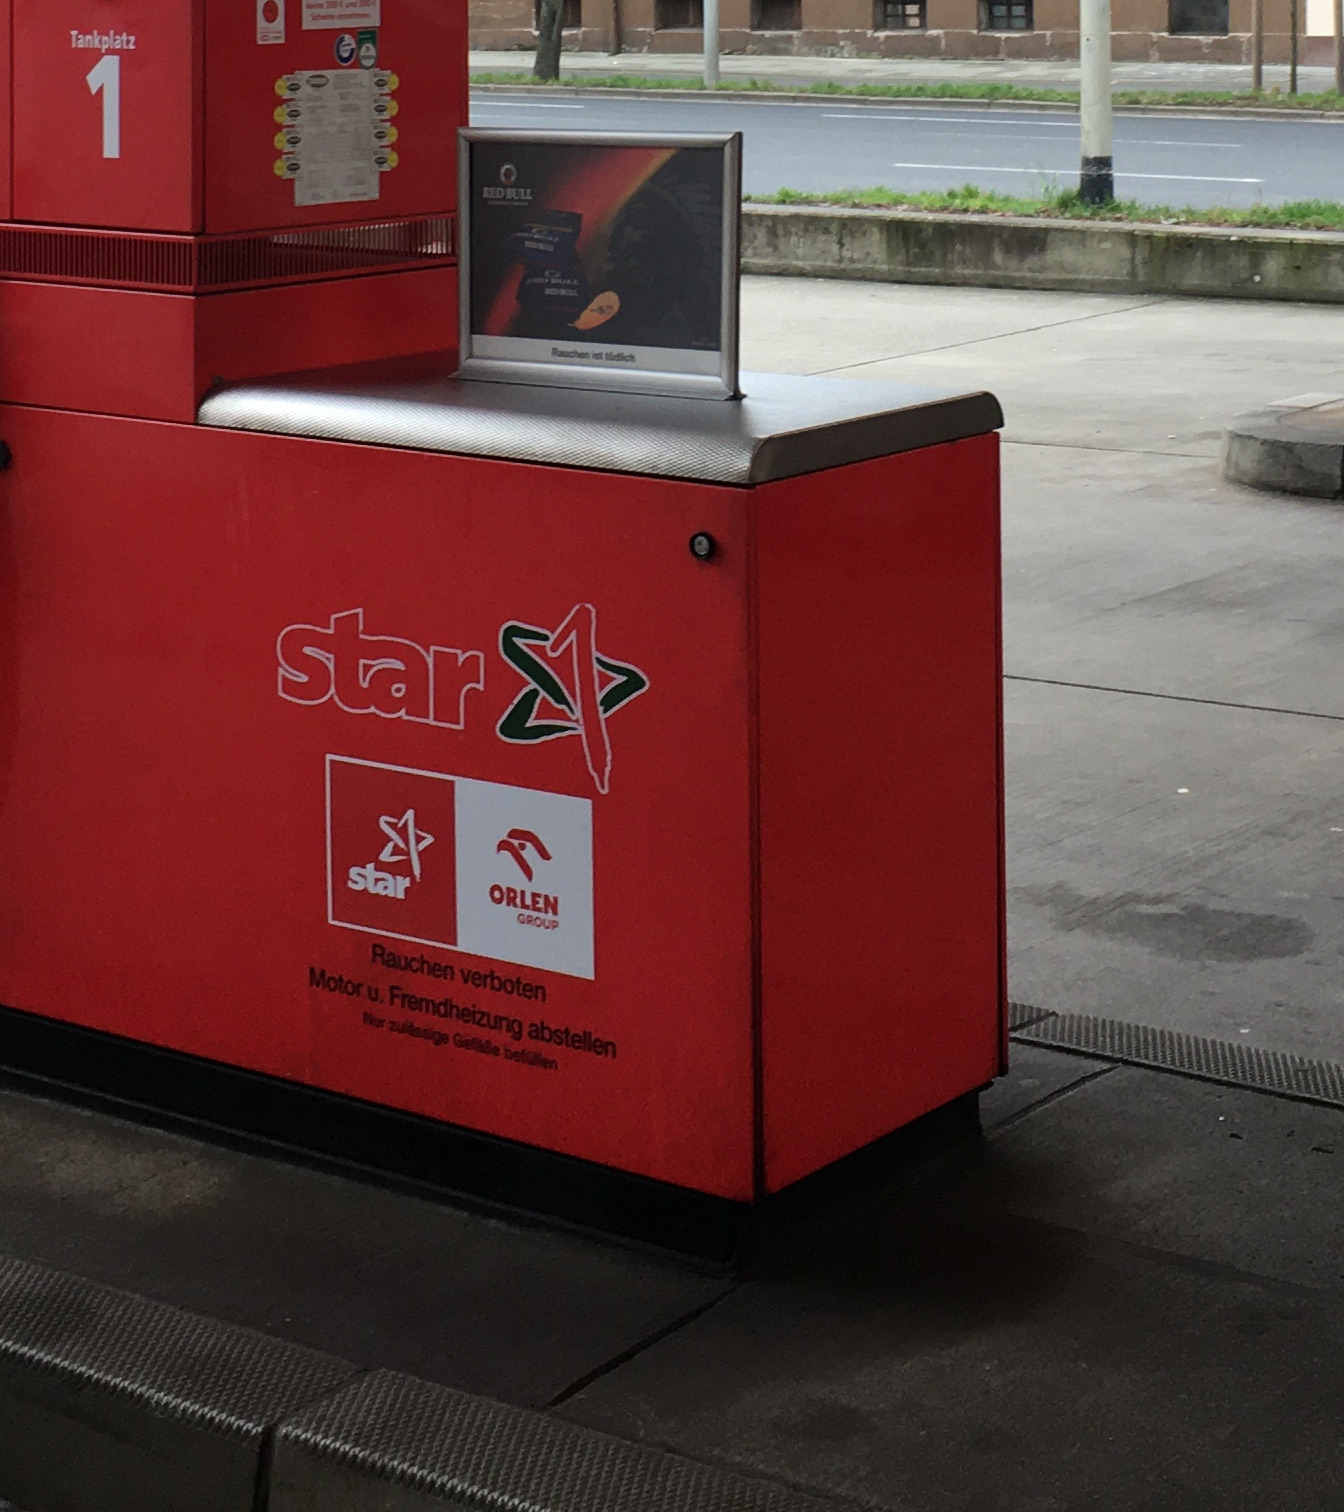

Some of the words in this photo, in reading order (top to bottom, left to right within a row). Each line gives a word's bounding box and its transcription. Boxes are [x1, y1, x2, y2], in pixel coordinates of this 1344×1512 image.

[70, 30, 136, 52] Tankplatz
[86, 55, 120, 159] 1
[551, 347, 590, 360] Rauchen
[276, 607, 484, 730] star
[347, 862, 411, 899] star
[489, 884, 559, 916] ORLEN
[517, 913, 559, 931] GROUP
[371, 943, 455, 980] Rauchen
[459, 967, 547, 1003] verboten
[308, 966, 362, 997] Motor
[367, 987, 384, 1004] u.
[389, 985, 523, 1042] Fremdheizung
[527, 1021, 618, 1059] abstellen
